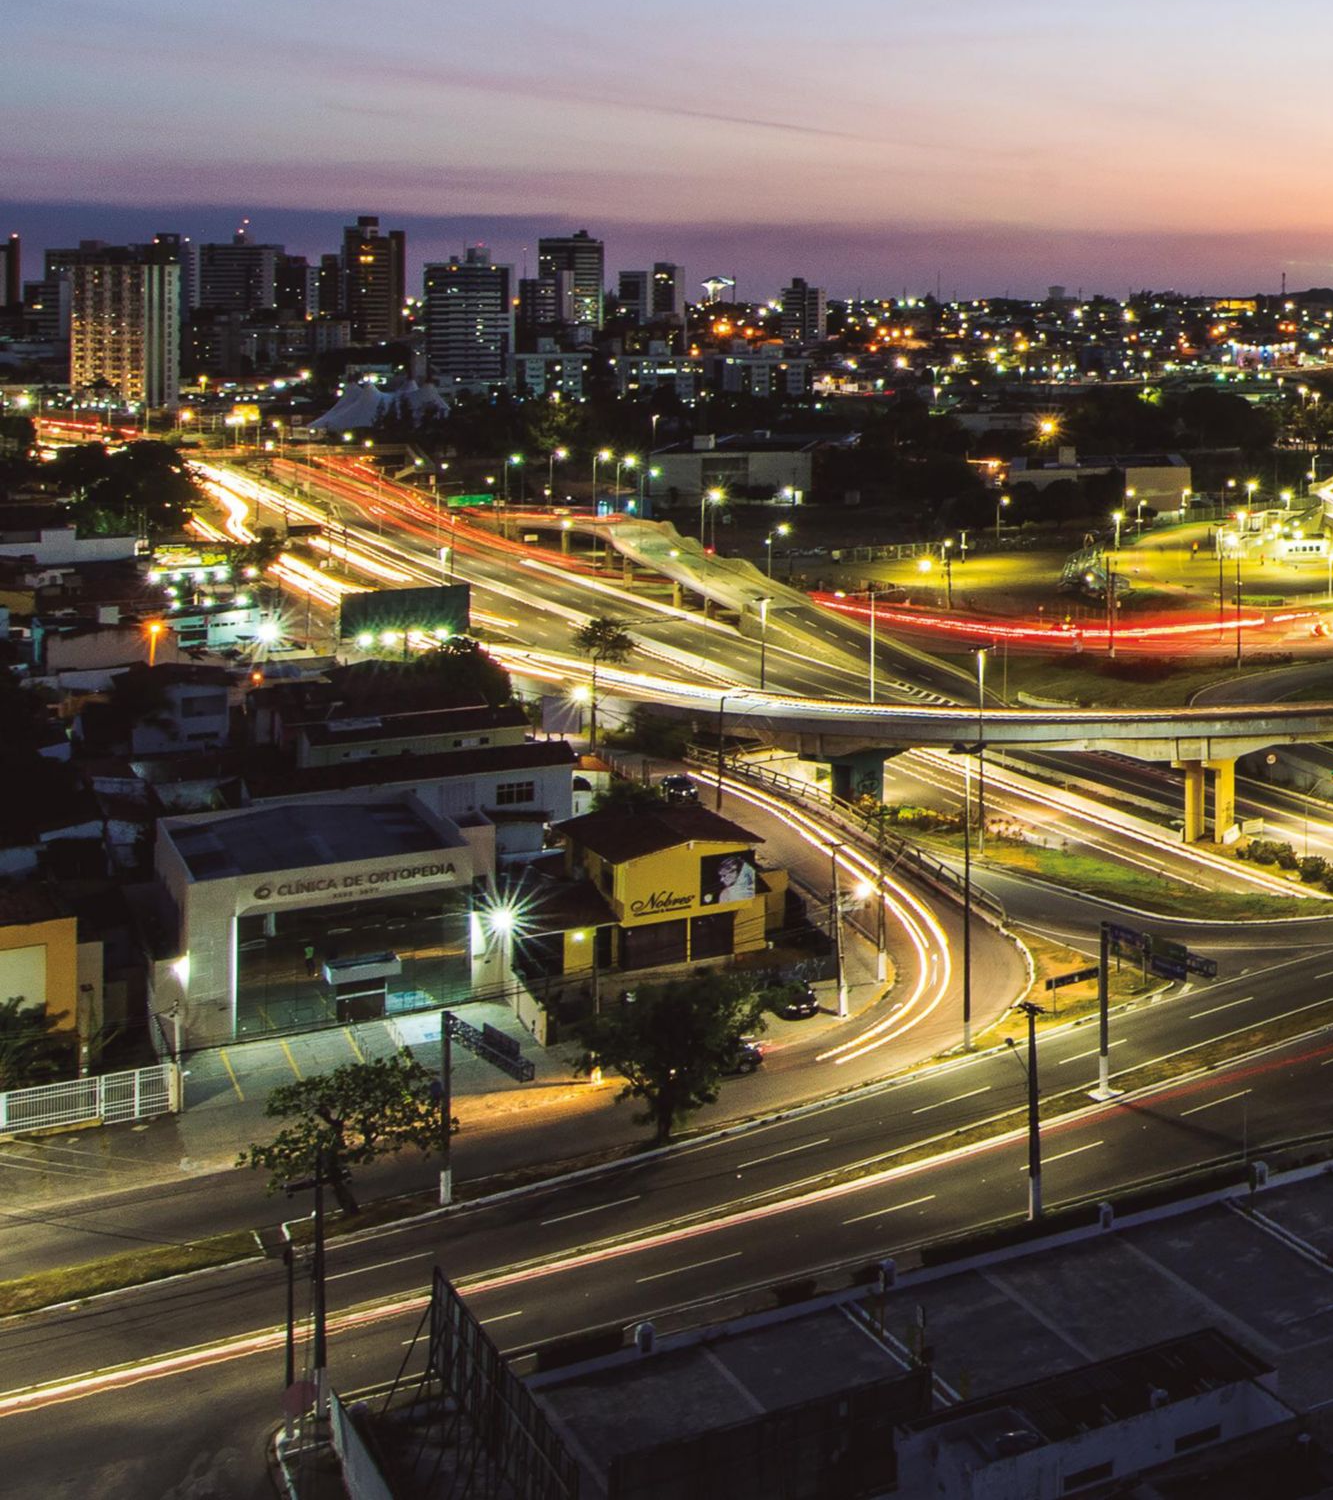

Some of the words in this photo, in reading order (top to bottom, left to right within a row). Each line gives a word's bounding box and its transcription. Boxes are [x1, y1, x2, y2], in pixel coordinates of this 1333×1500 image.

[277, 879, 337, 896] CLÍNICA
[343, 875, 363, 887] DE
[368, 863, 456, 885] ORTOPEDIA
